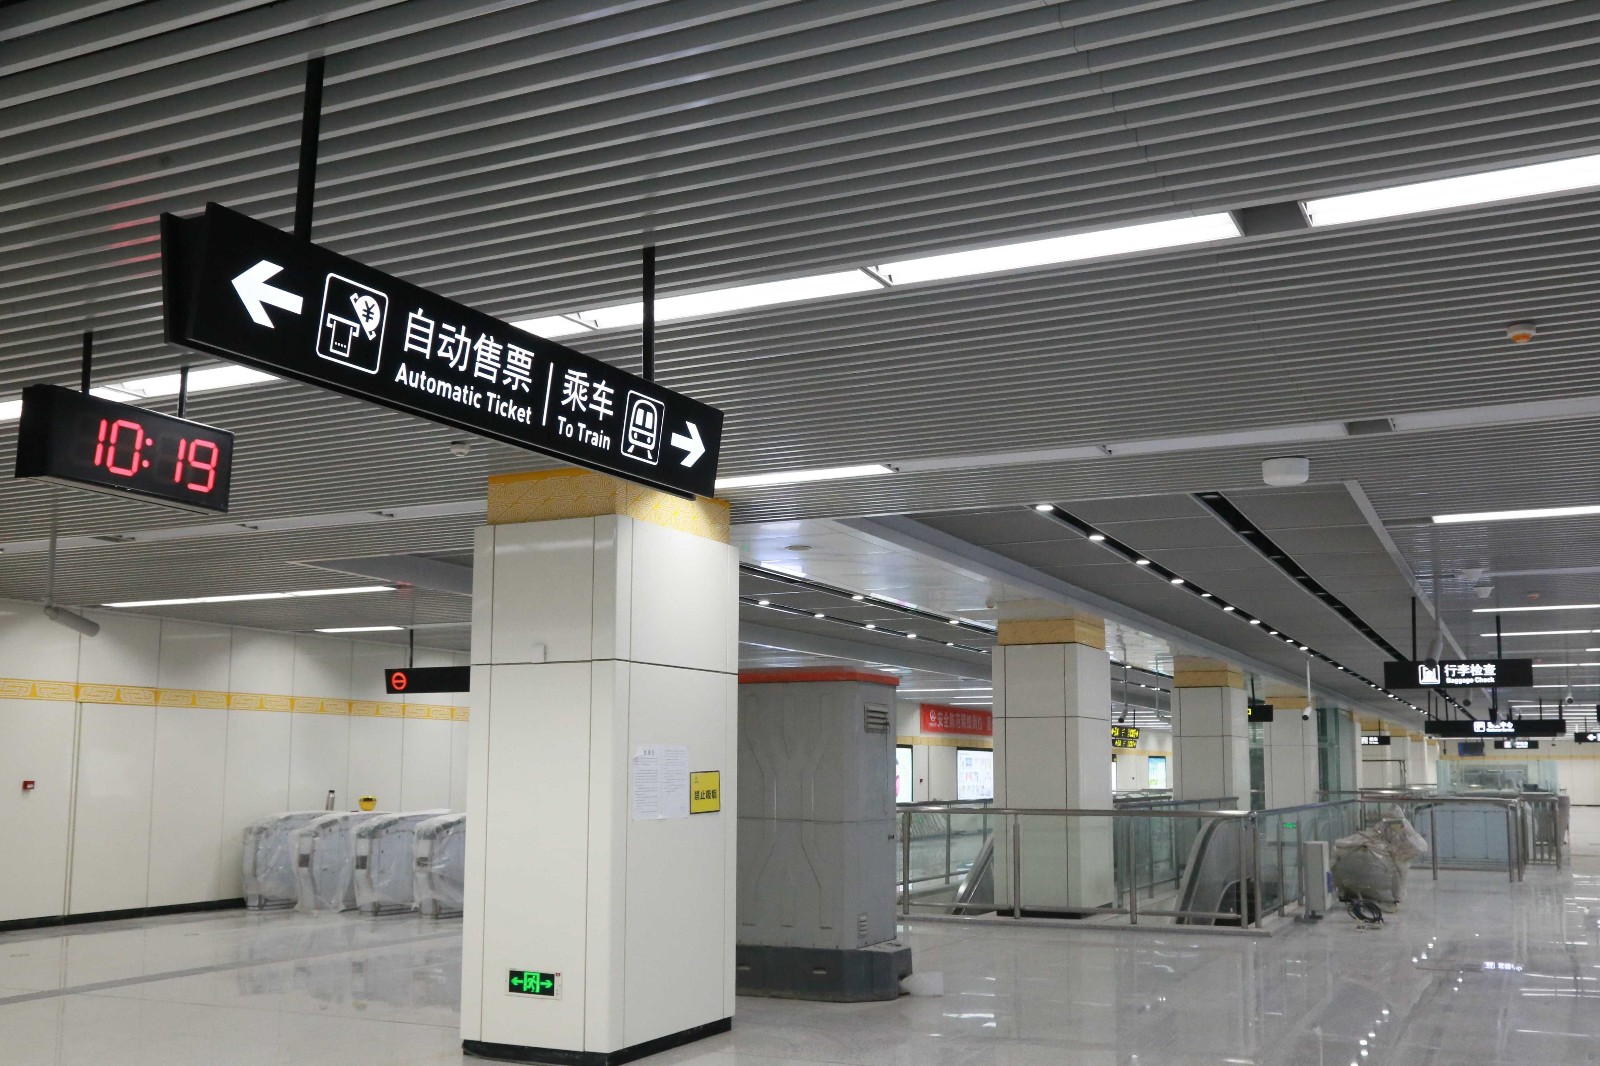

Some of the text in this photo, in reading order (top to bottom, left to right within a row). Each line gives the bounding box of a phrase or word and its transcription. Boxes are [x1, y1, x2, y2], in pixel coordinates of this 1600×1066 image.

[403, 307, 535, 393] 自动售票
[394, 362, 532, 425] Automatic Ticket
[560, 368, 615, 422] 乘车
[94, 418, 219, 493] 10:19
[557, 416, 611, 451] To Train
[1444, 663, 1496, 676] 行李检查
